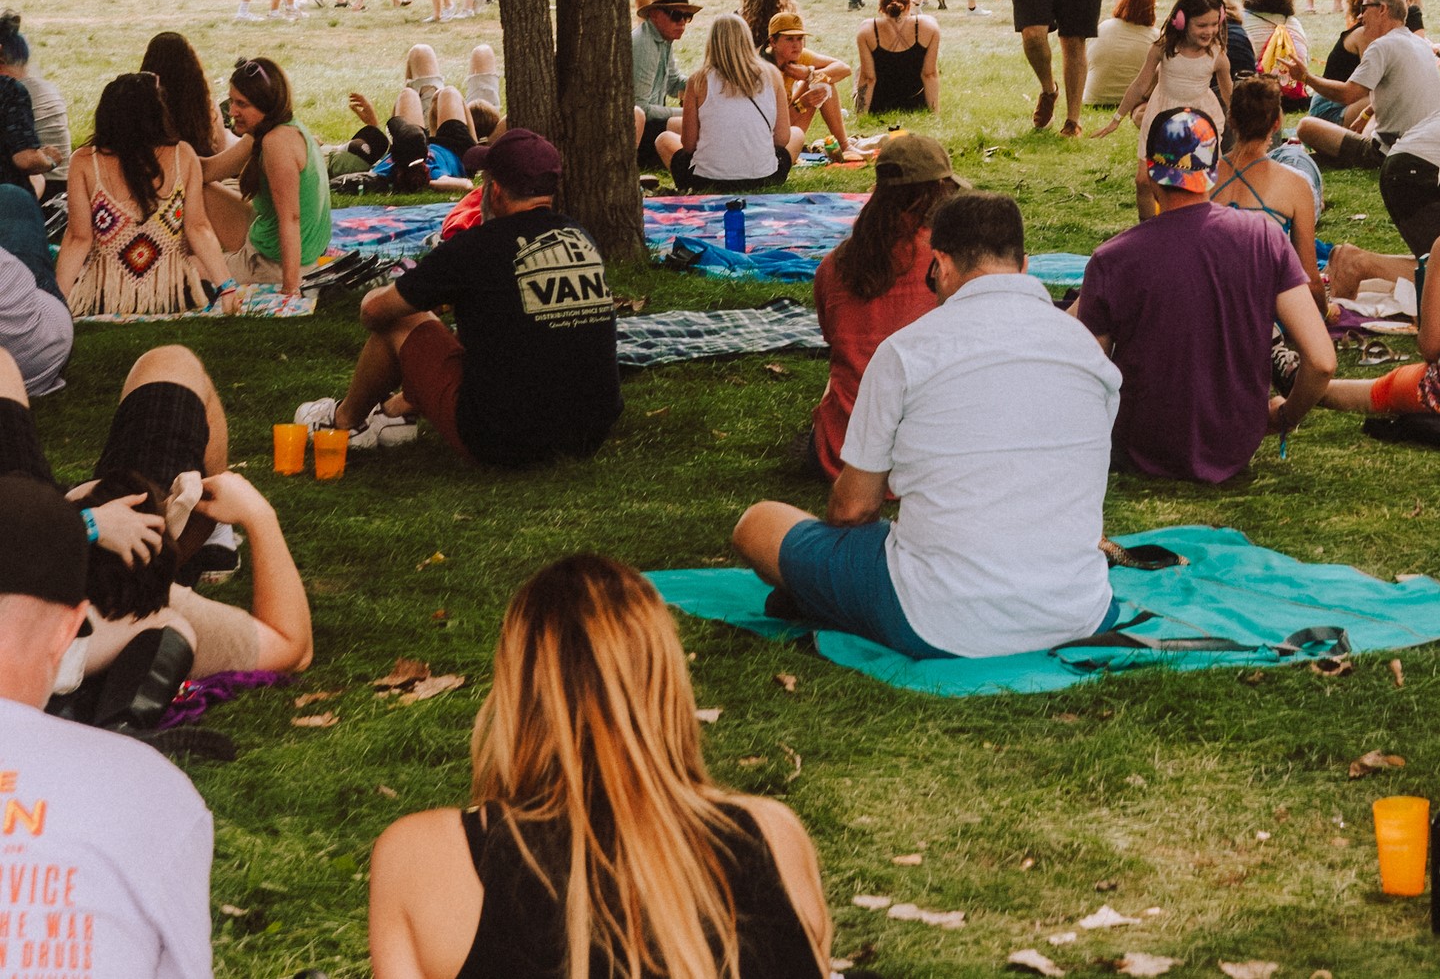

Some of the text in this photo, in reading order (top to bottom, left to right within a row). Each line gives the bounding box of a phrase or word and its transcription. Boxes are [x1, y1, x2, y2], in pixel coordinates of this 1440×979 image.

[535, 310, 580, 321] DISTRIBUTION
[0, 864, 77, 907] VICE
[46, 911, 94, 940] WAR
